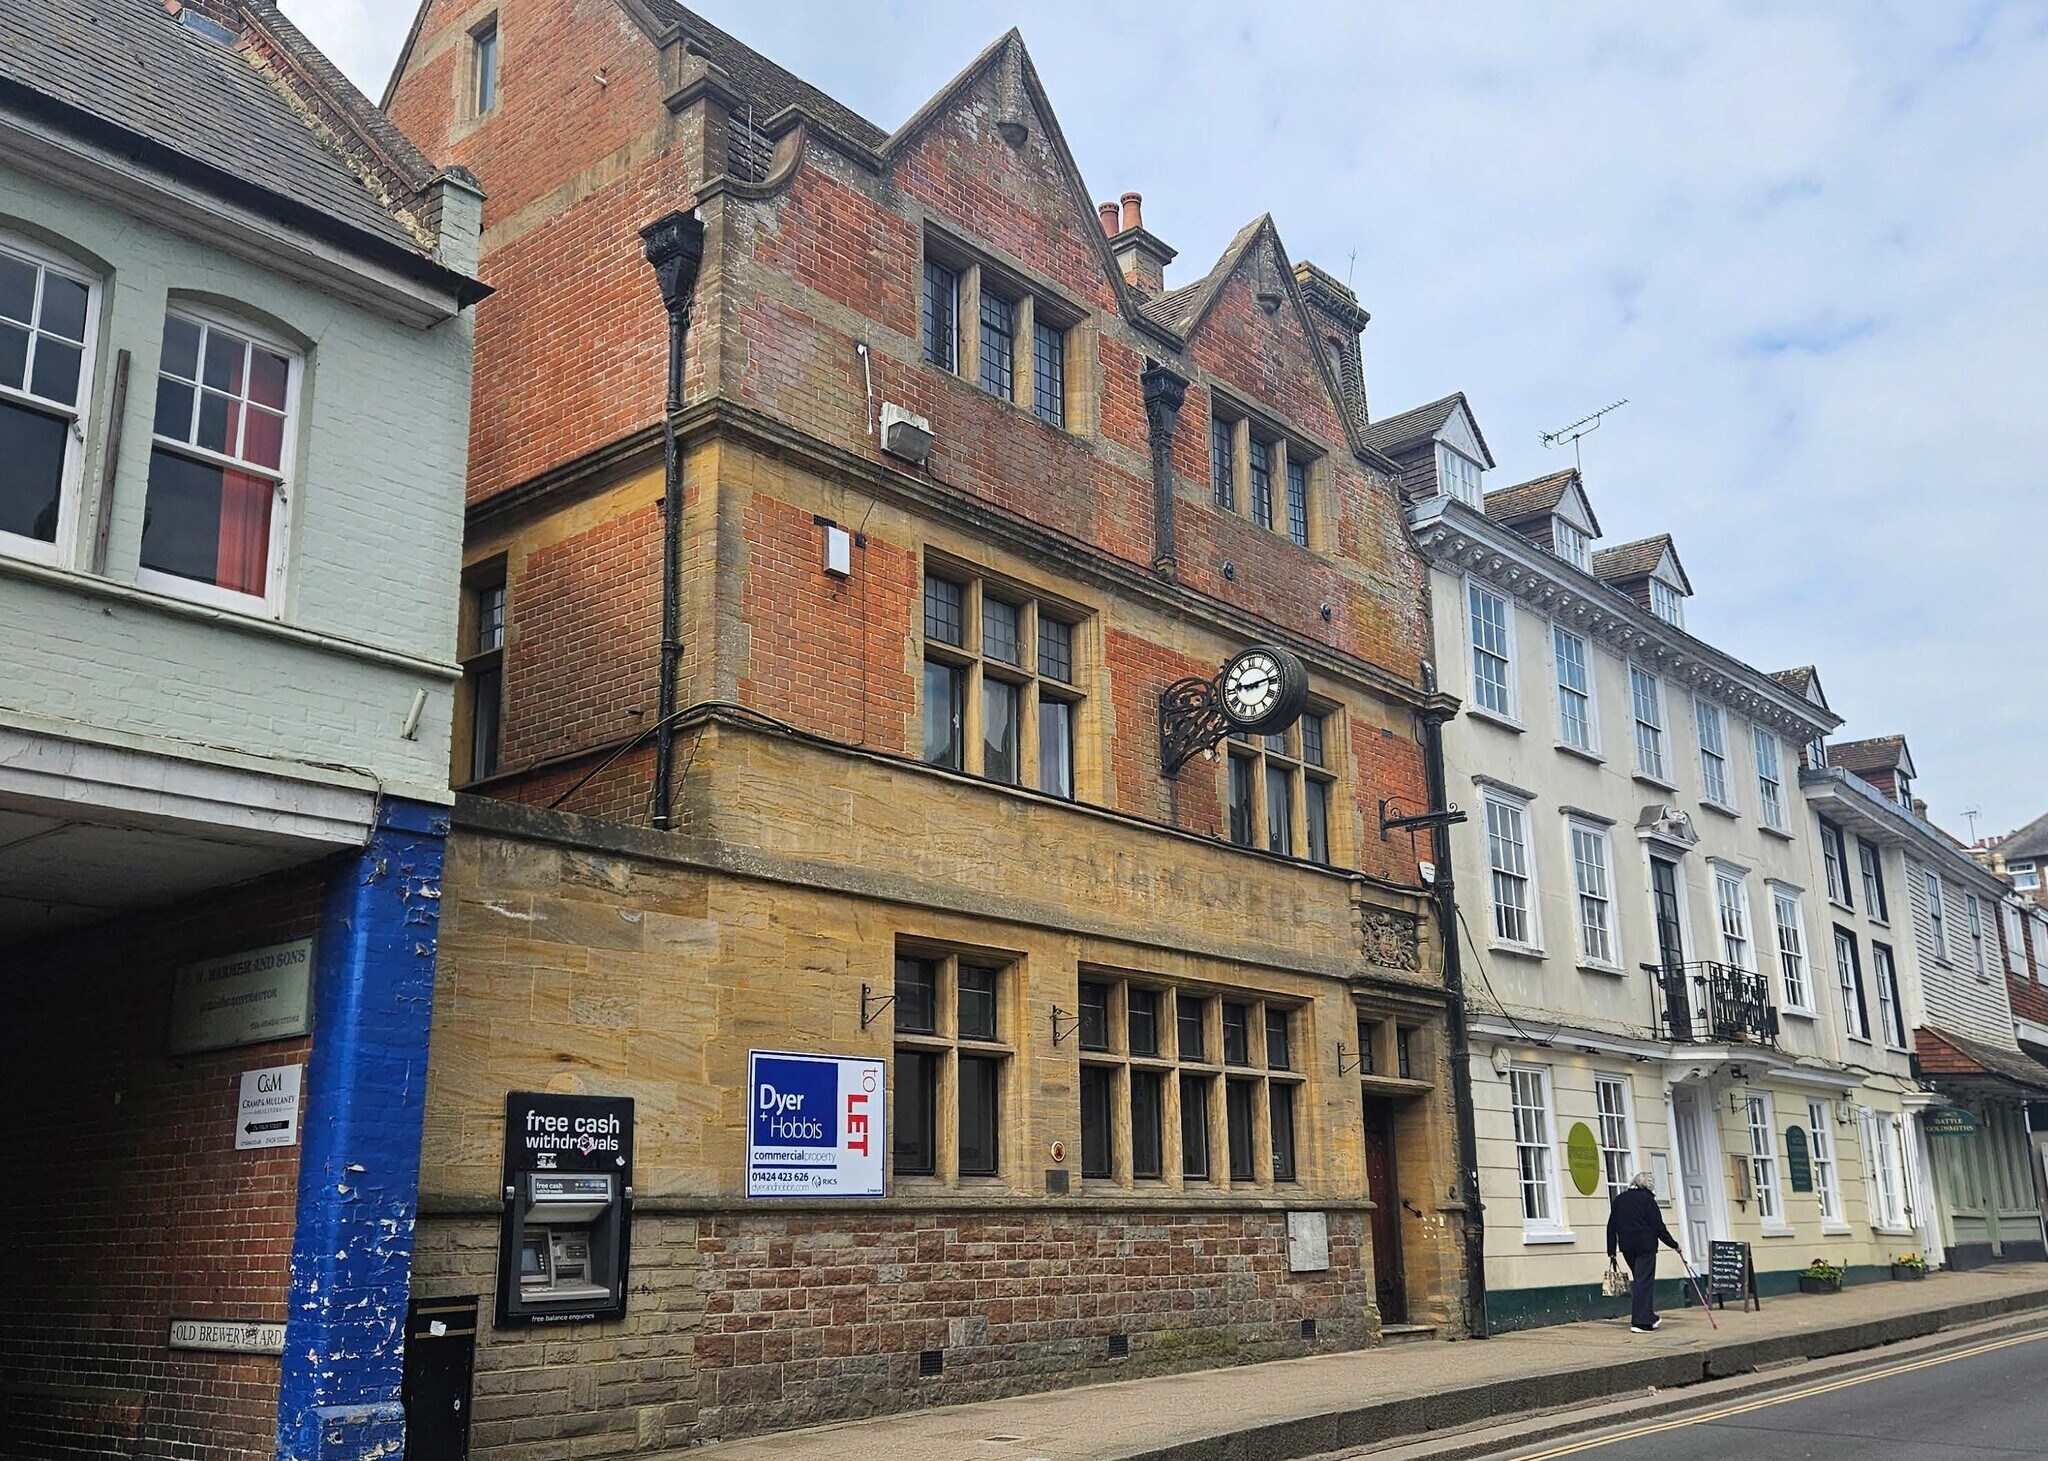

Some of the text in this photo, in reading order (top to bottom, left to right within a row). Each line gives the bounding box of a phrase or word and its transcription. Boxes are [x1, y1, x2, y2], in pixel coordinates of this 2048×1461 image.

[252, 956, 274, 972] AND
[276, 948, 306, 968] SONS
[760, 1084, 804, 1116] Dyer
[526, 1110, 620, 1134] free cash
[770, 1116, 822, 1139] Hobbis
[848, 1094, 868, 1157] LET
[752, 1172, 809, 1182] 01424 423 626
[176, 1325, 196, 1340] OLD
